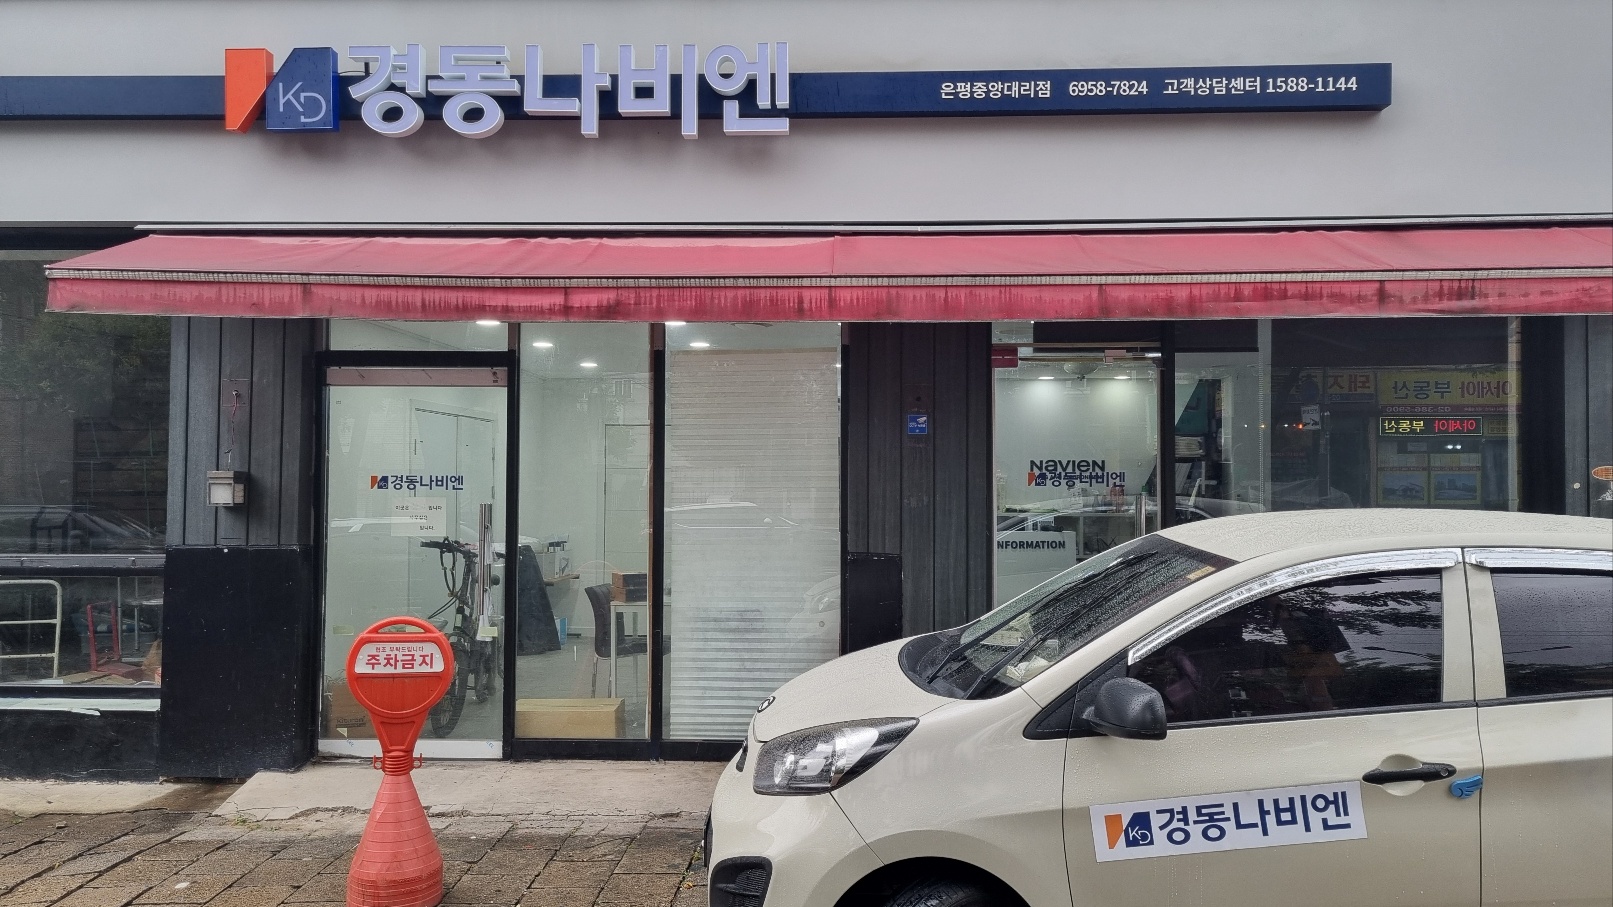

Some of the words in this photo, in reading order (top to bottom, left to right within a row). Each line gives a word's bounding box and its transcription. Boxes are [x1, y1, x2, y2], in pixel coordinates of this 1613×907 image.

[347, 42, 790, 139] 경동나비엔
[939, 80, 1052, 99] 은평중앙대리점
[1068, 80, 1148, 97] 6958-7824
[1163, 77, 1262, 96] 고객상담센터
[1265, 76, 1358, 93] 1588-1144
[278, 81, 327, 123] KD
[390, 475, 464, 490] 경동나비엔
[1048, 471, 1126, 488] 경동나비엔
[365, 653, 434, 670] 주차금지
[1155, 790, 1352, 846] 경동나비엔
[1129, 825, 1151, 845] KD
